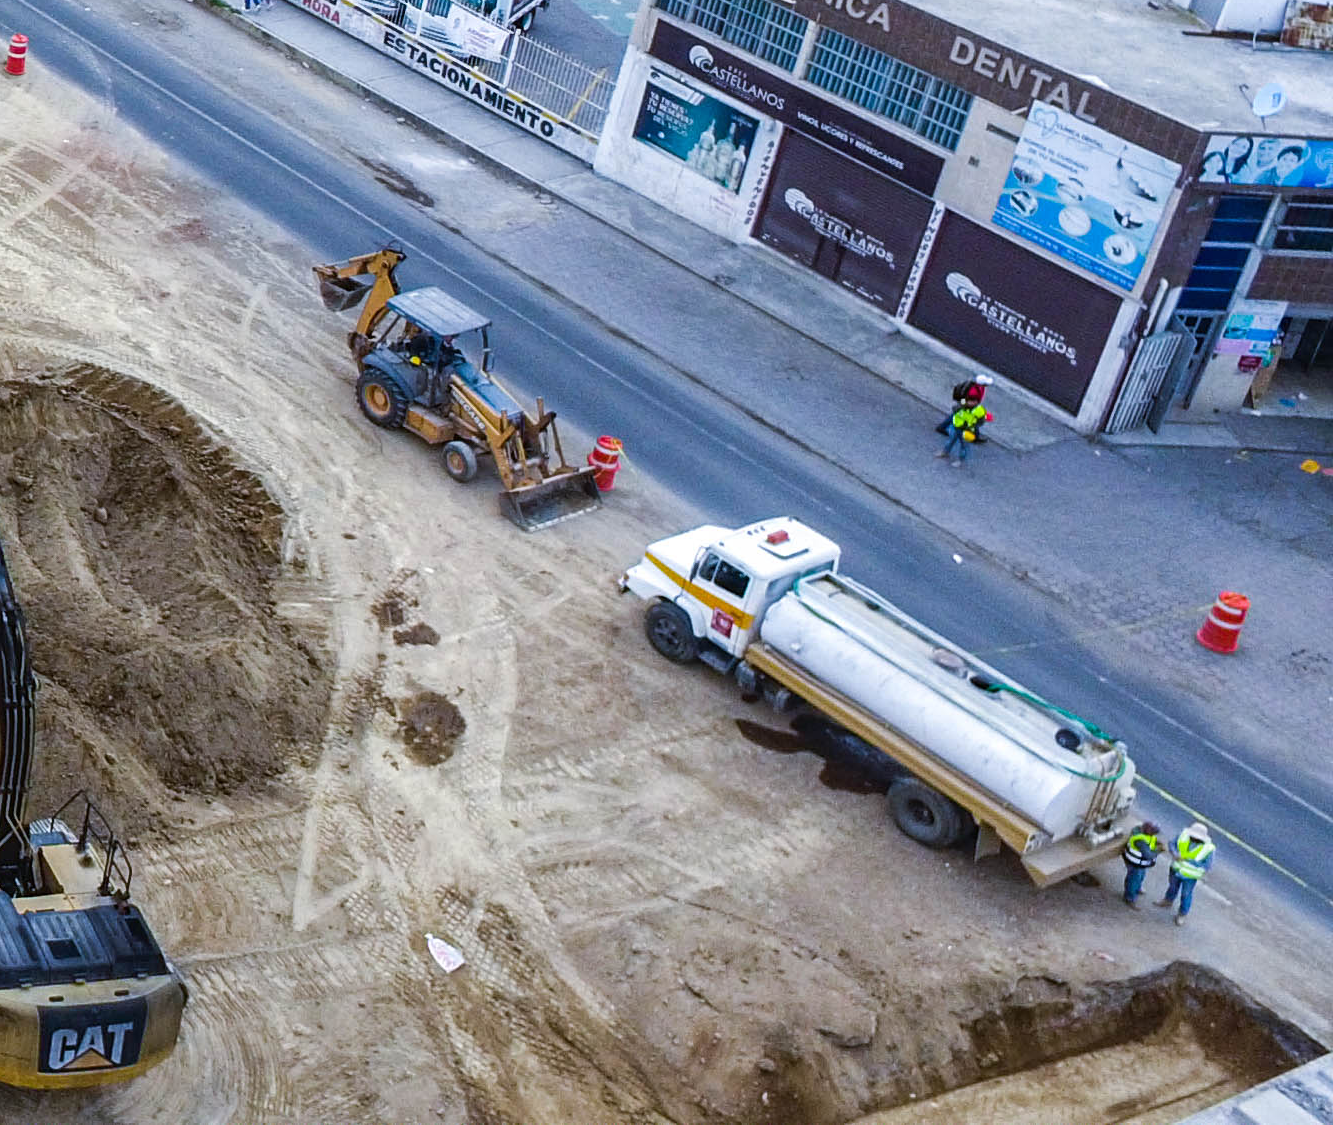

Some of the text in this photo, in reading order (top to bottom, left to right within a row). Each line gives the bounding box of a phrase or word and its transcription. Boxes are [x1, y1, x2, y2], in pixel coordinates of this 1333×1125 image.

[383, 31, 554, 137] ESTACIONAMIENTO
[700, 59, 785, 111] CASTELLANOS
[949, 35, 1097, 124] DENTAL
[801, 206, 895, 264] CASTELLANOS
[967, 294, 1077, 360] CASTELLANOS
[48, 1021, 134, 1071] CAT
